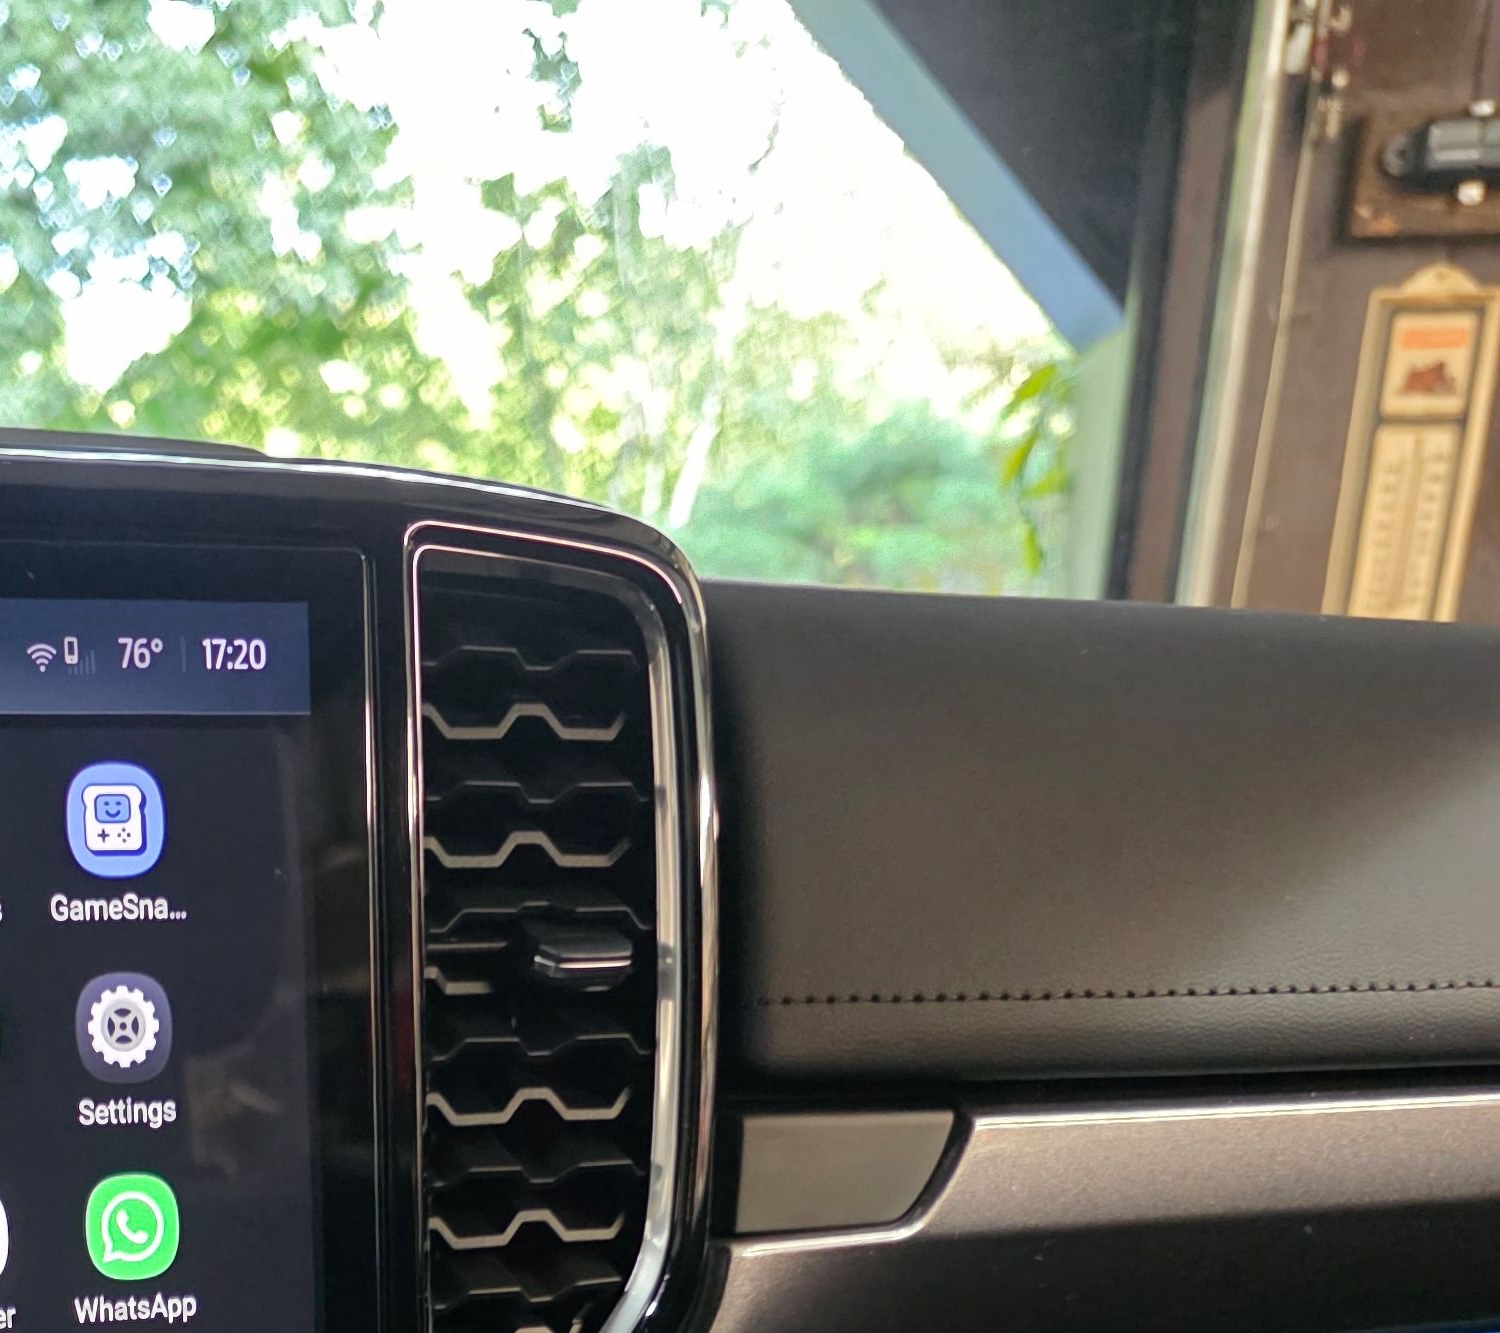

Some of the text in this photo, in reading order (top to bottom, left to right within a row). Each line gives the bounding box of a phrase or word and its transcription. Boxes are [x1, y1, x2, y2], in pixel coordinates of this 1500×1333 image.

[201, 638, 268, 670] 17:20
[77, 1096, 178, 1130] Settings
[73, 1292, 198, 1325] WhatsApp
